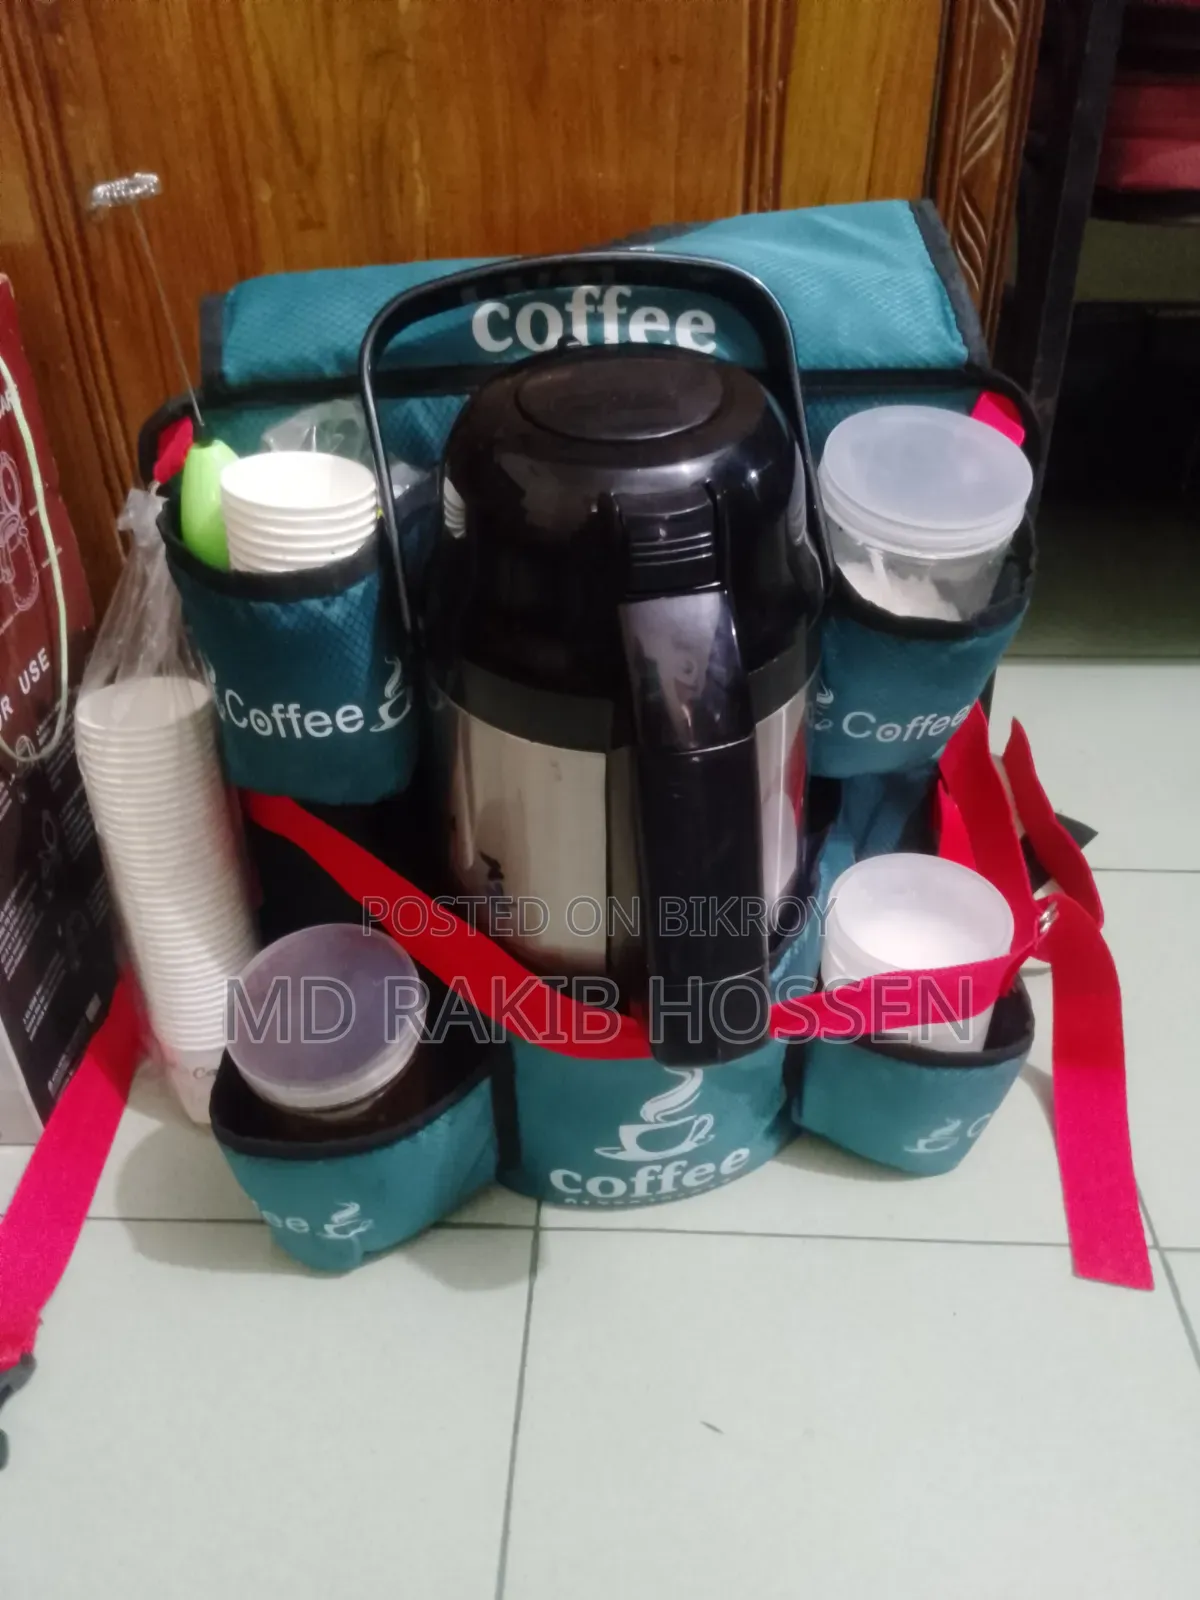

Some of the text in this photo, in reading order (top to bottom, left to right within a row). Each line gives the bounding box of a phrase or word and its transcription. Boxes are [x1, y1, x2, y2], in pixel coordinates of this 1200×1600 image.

[471, 284, 717, 354] coffee
[18, 647, 50, 695] USE
[224, 688, 365, 739] Coffee
[549, 1147, 751, 1198] coffee
